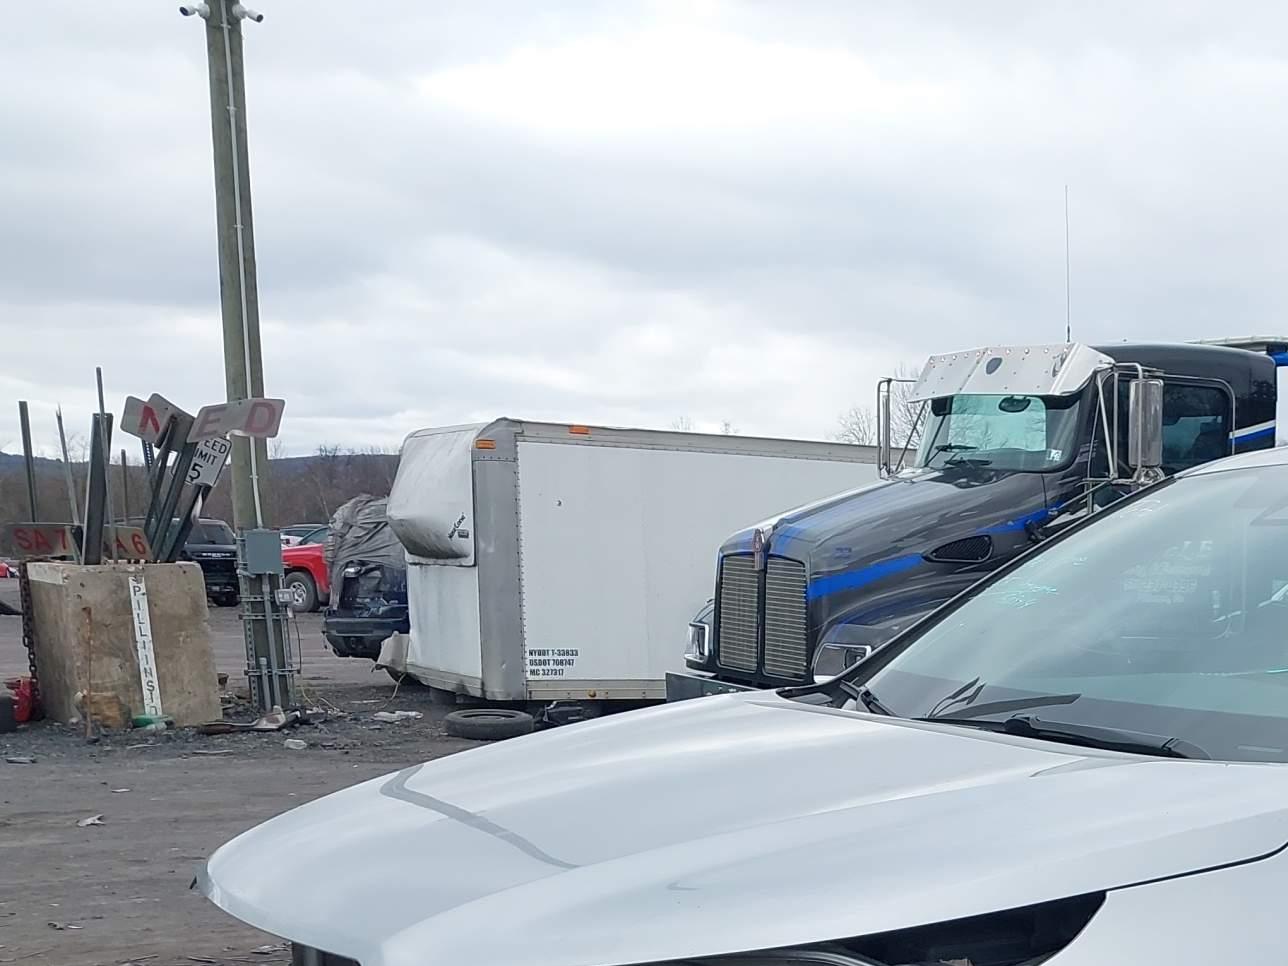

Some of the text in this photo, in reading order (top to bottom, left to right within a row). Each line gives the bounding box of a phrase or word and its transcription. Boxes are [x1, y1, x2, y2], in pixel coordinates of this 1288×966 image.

[194, 447, 218, 465] IMIT
[131, 533, 146, 555] 6
[529, 668, 541, 676] MC
